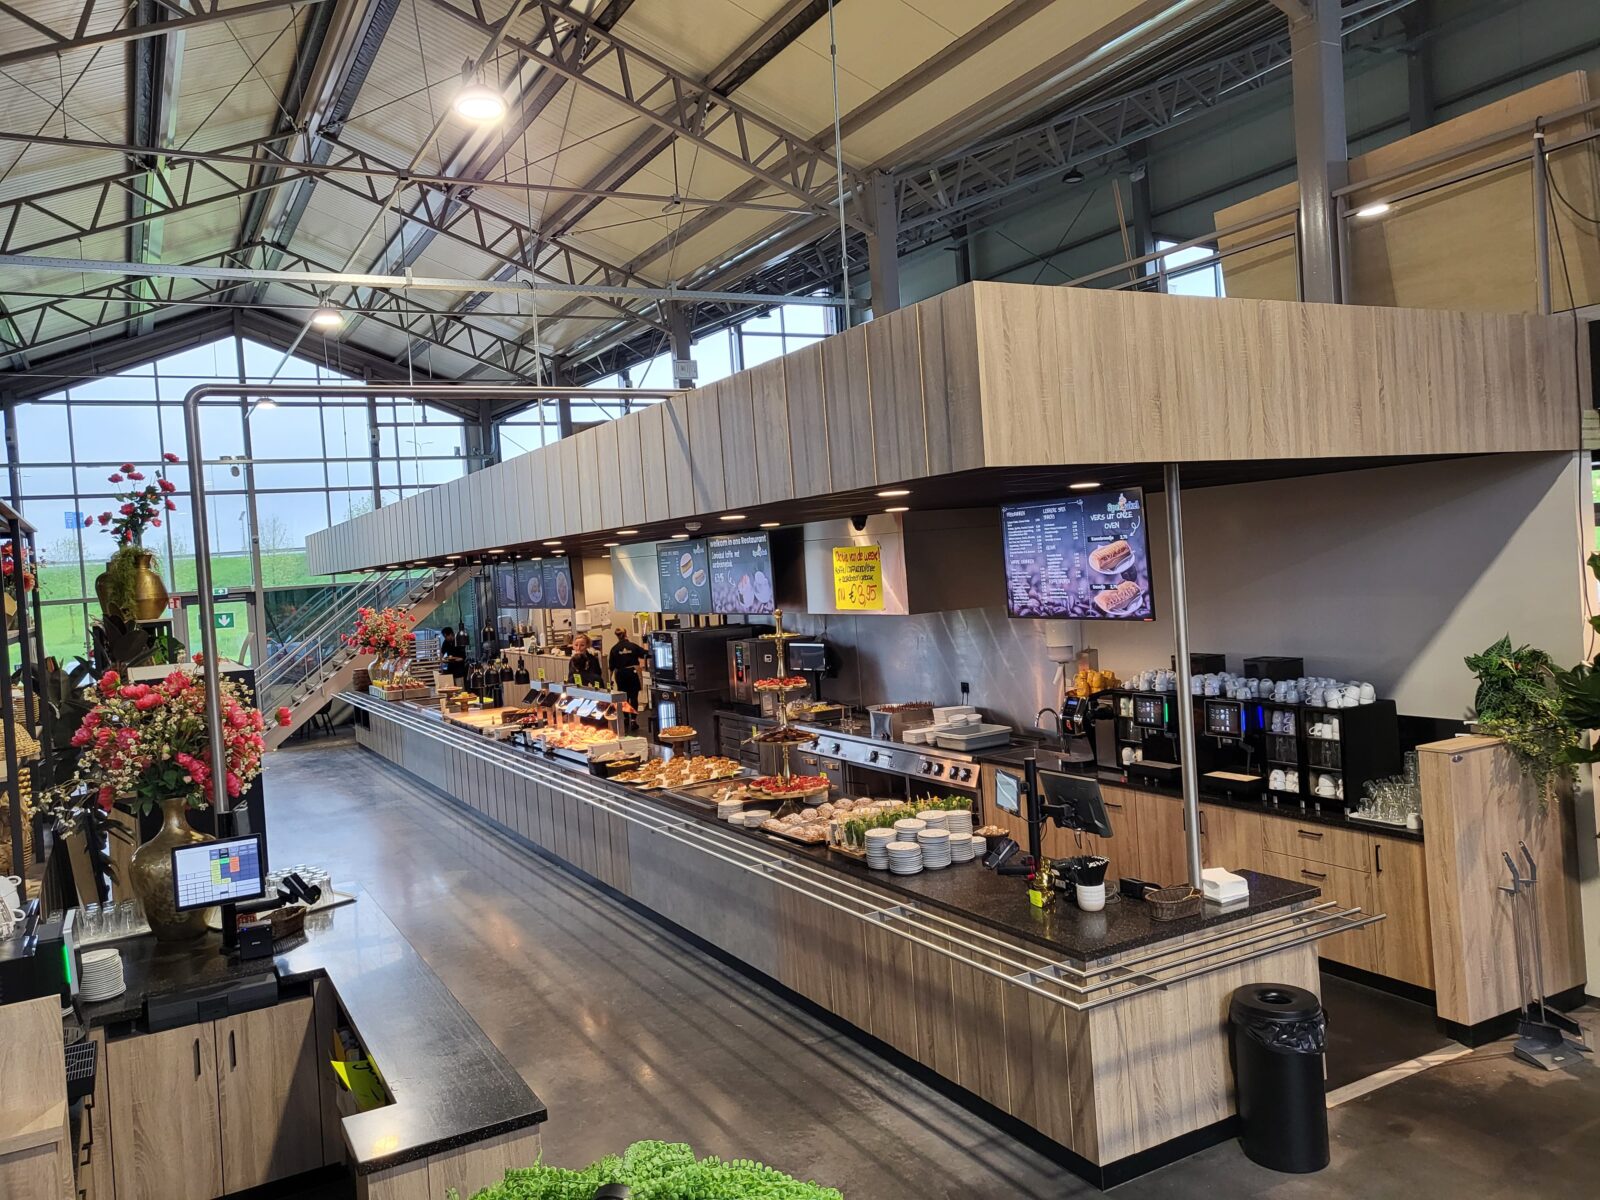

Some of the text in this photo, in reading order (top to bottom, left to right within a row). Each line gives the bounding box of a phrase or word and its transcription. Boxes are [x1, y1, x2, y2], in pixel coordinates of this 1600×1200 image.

[1090, 510, 1133, 521] VERS UIT ONZE
[1104, 521, 1120, 530] OVEN
[740, 534, 767, 545] Restaurant
